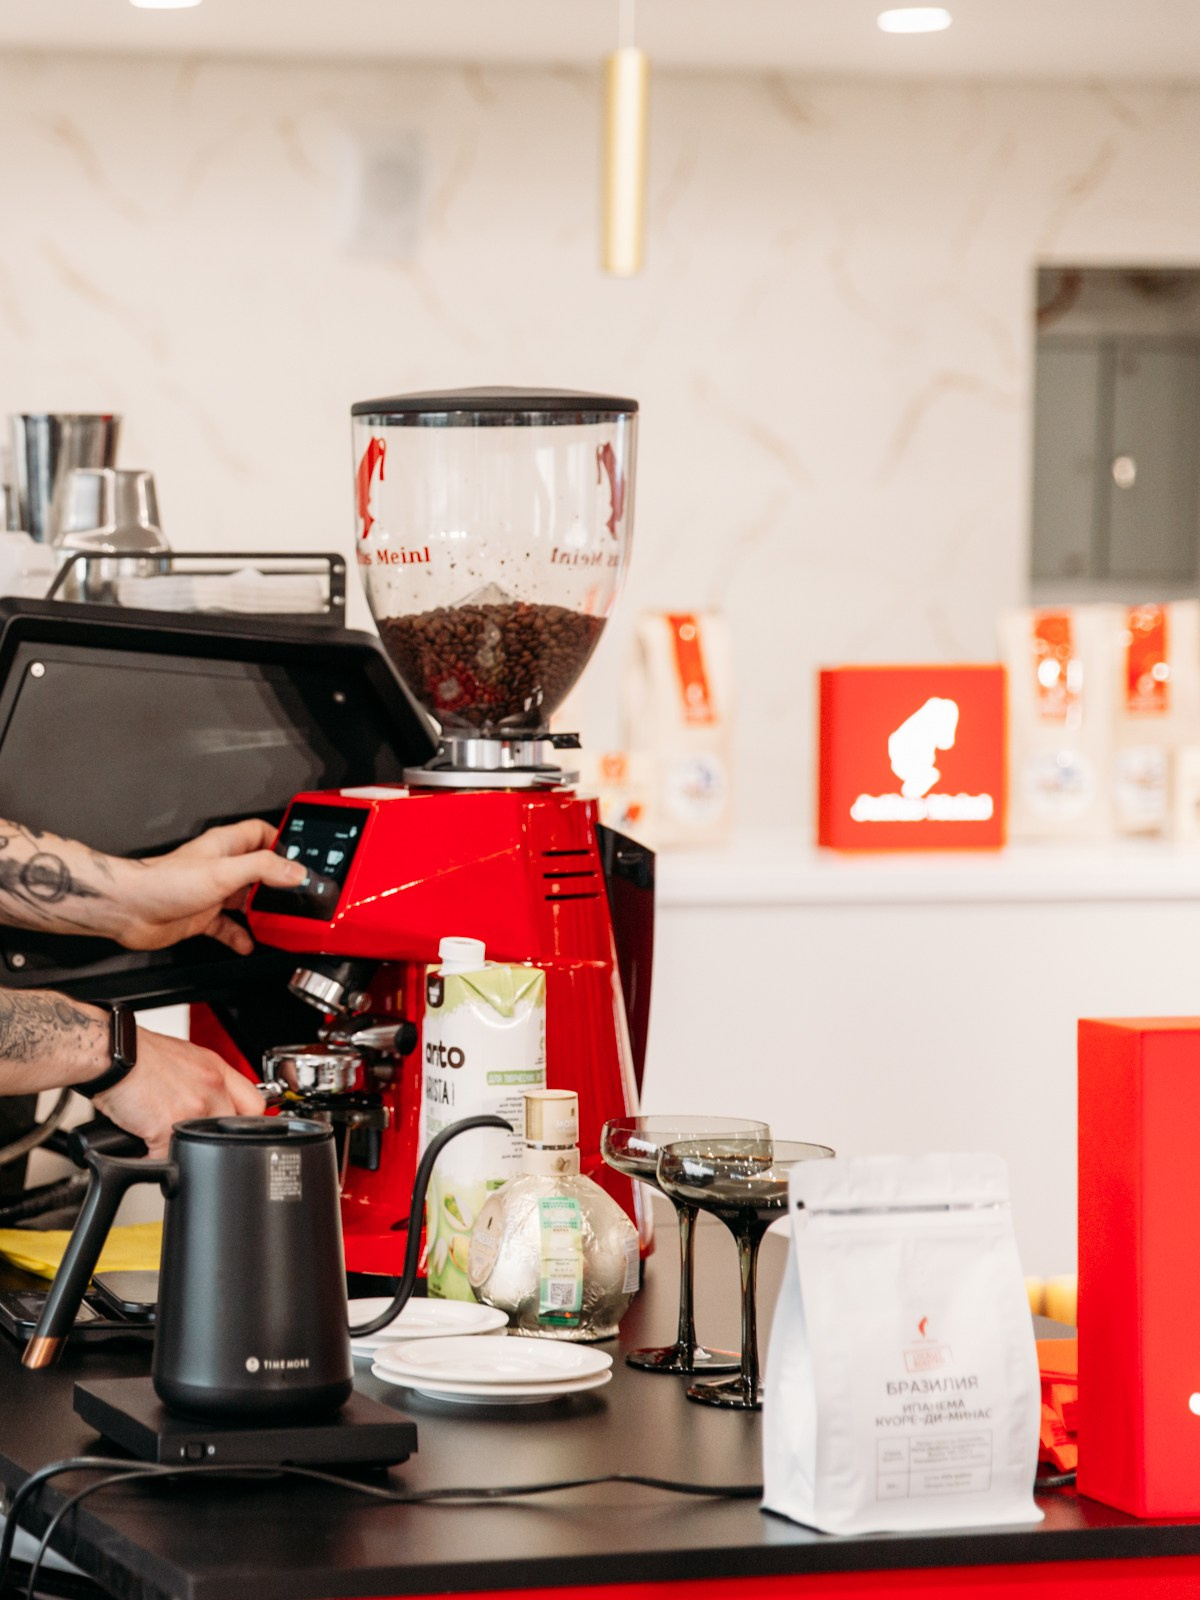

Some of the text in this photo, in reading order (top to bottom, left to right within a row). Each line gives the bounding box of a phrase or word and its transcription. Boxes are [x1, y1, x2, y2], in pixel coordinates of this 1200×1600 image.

[377, 546, 430, 565] Meinl
[886, 1376, 979, 1395] БРАЗИЛИЯ
[902, 1399, 966, 1414] ИПАНЕМА
